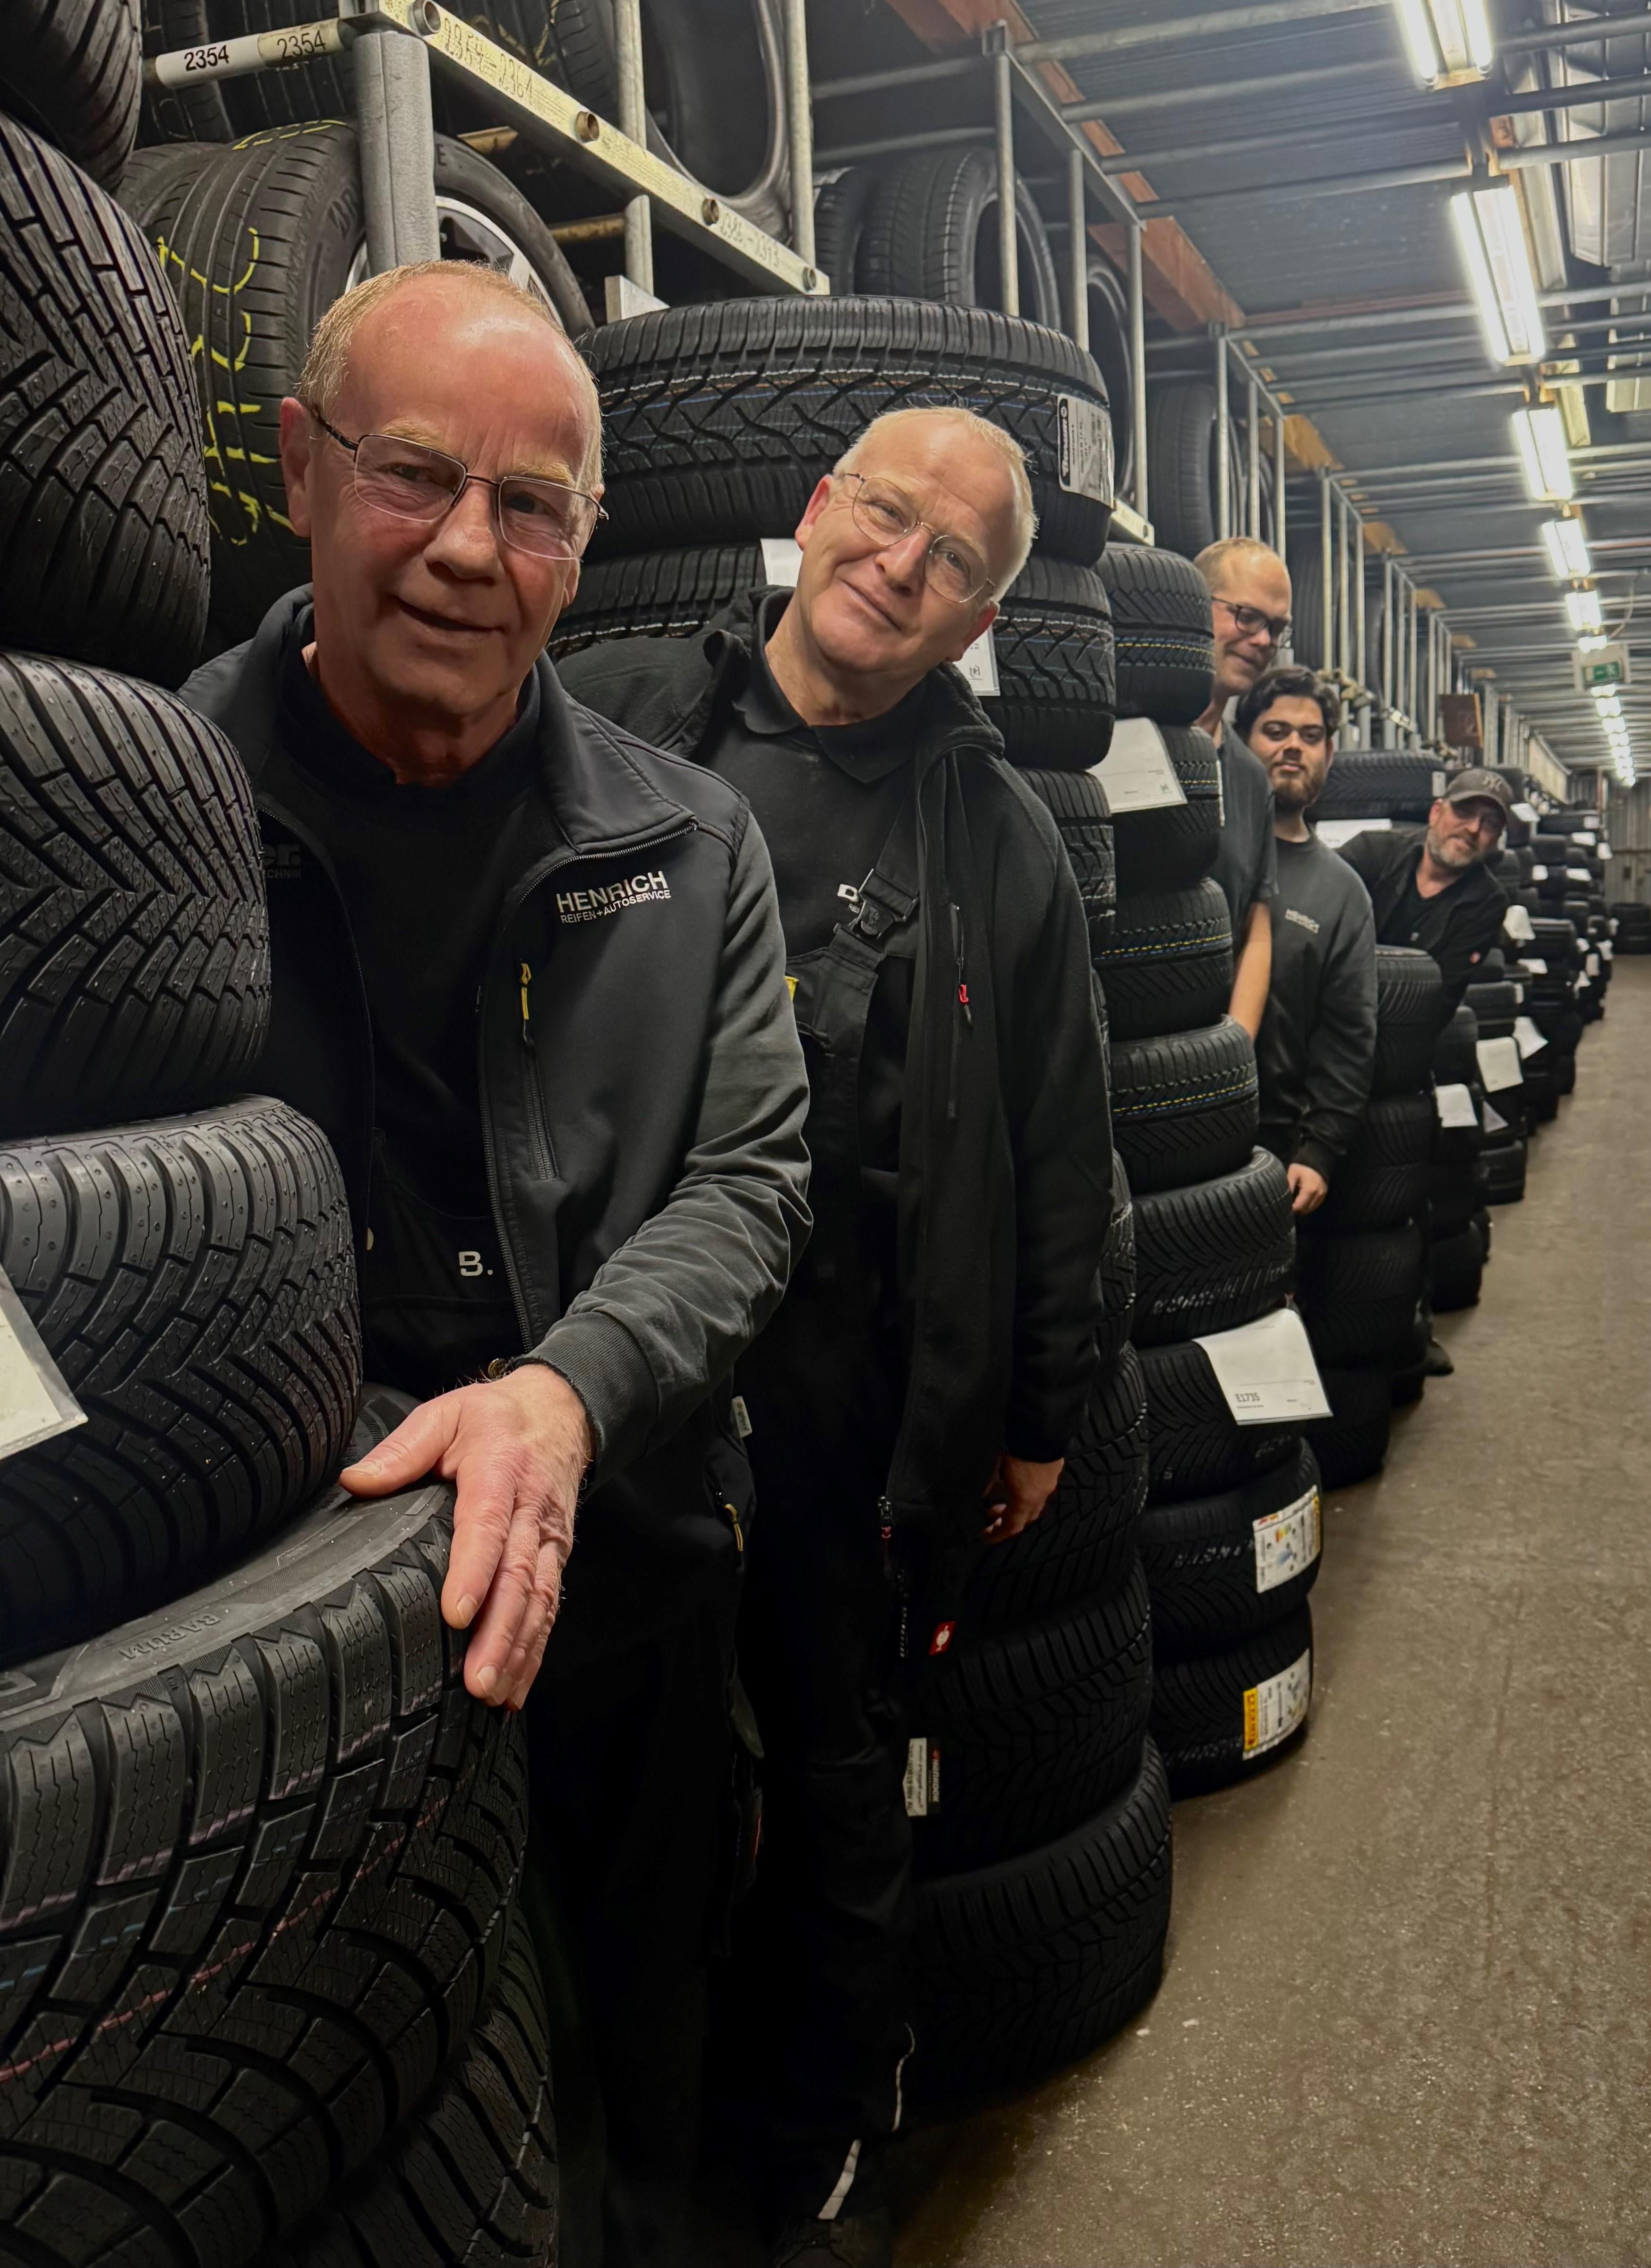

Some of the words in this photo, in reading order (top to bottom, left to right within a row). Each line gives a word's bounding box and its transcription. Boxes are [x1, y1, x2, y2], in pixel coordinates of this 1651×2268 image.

[184, 45, 229, 71] 2354
[277, 30, 326, 59] 2354
[556, 870, 669, 913] HENRICH
[457, 1250, 493, 1277] B.
[120, 1614, 220, 1660] BARUM
